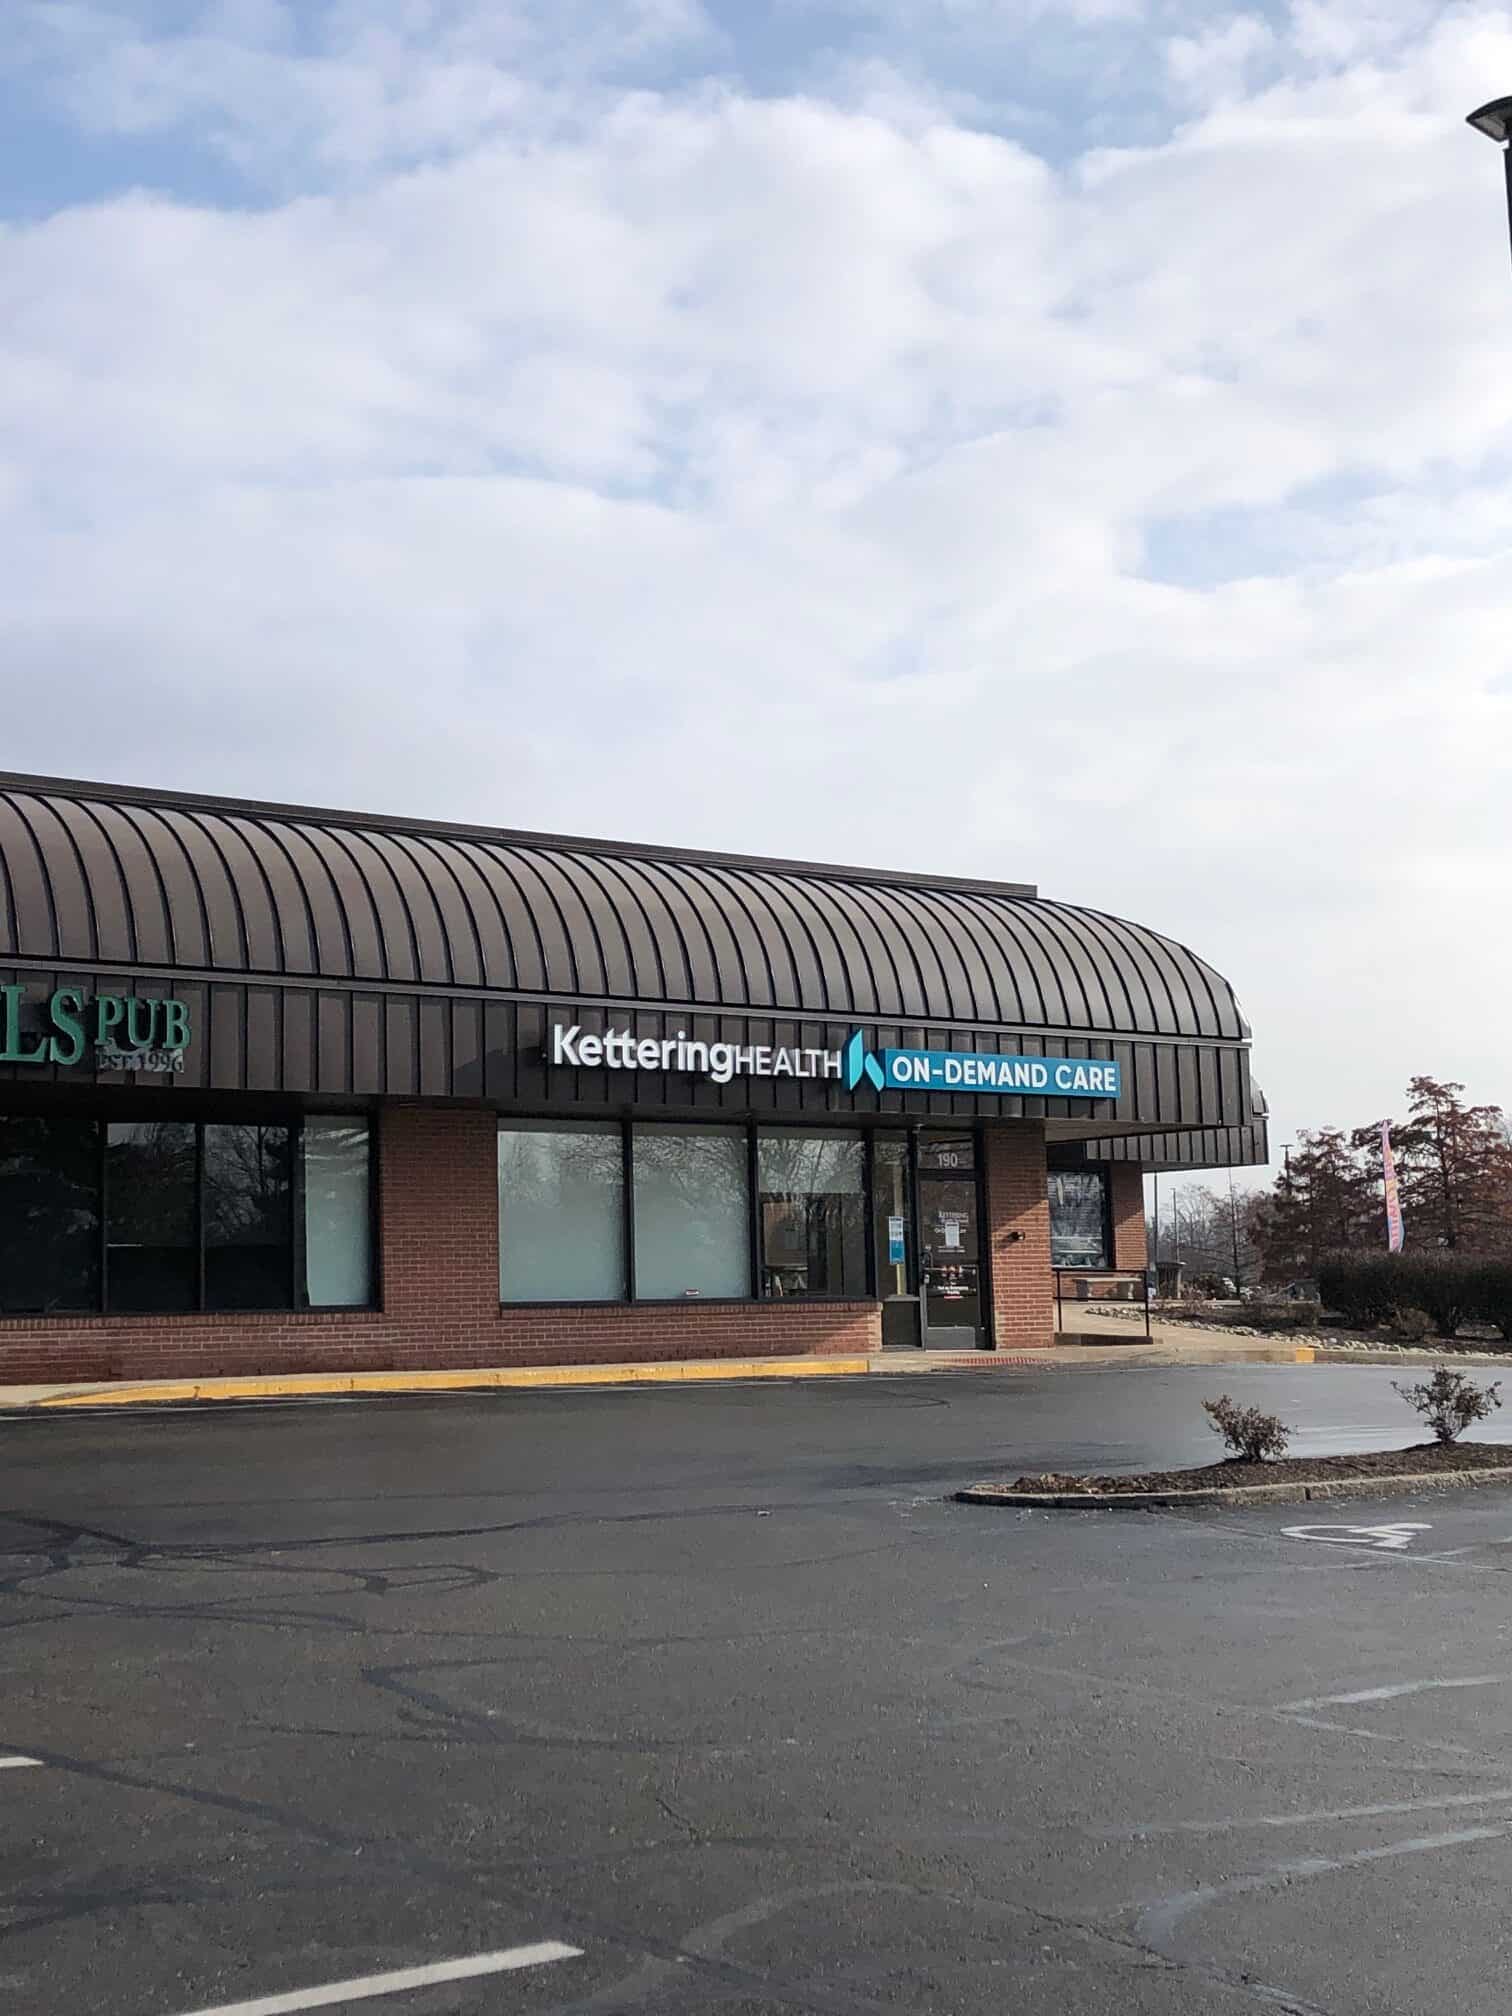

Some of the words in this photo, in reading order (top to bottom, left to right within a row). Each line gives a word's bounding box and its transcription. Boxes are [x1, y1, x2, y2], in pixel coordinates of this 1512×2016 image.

[94, 995, 191, 1049] PUB
[553, 1024, 734, 1083] Kettering
[735, 1046, 842, 1079] HEALTH
[892, 1056, 1048, 1088] ON-DEMAND
[1055, 1065, 1117, 1091] CARE
[938, 1152, 958, 1168] 190
